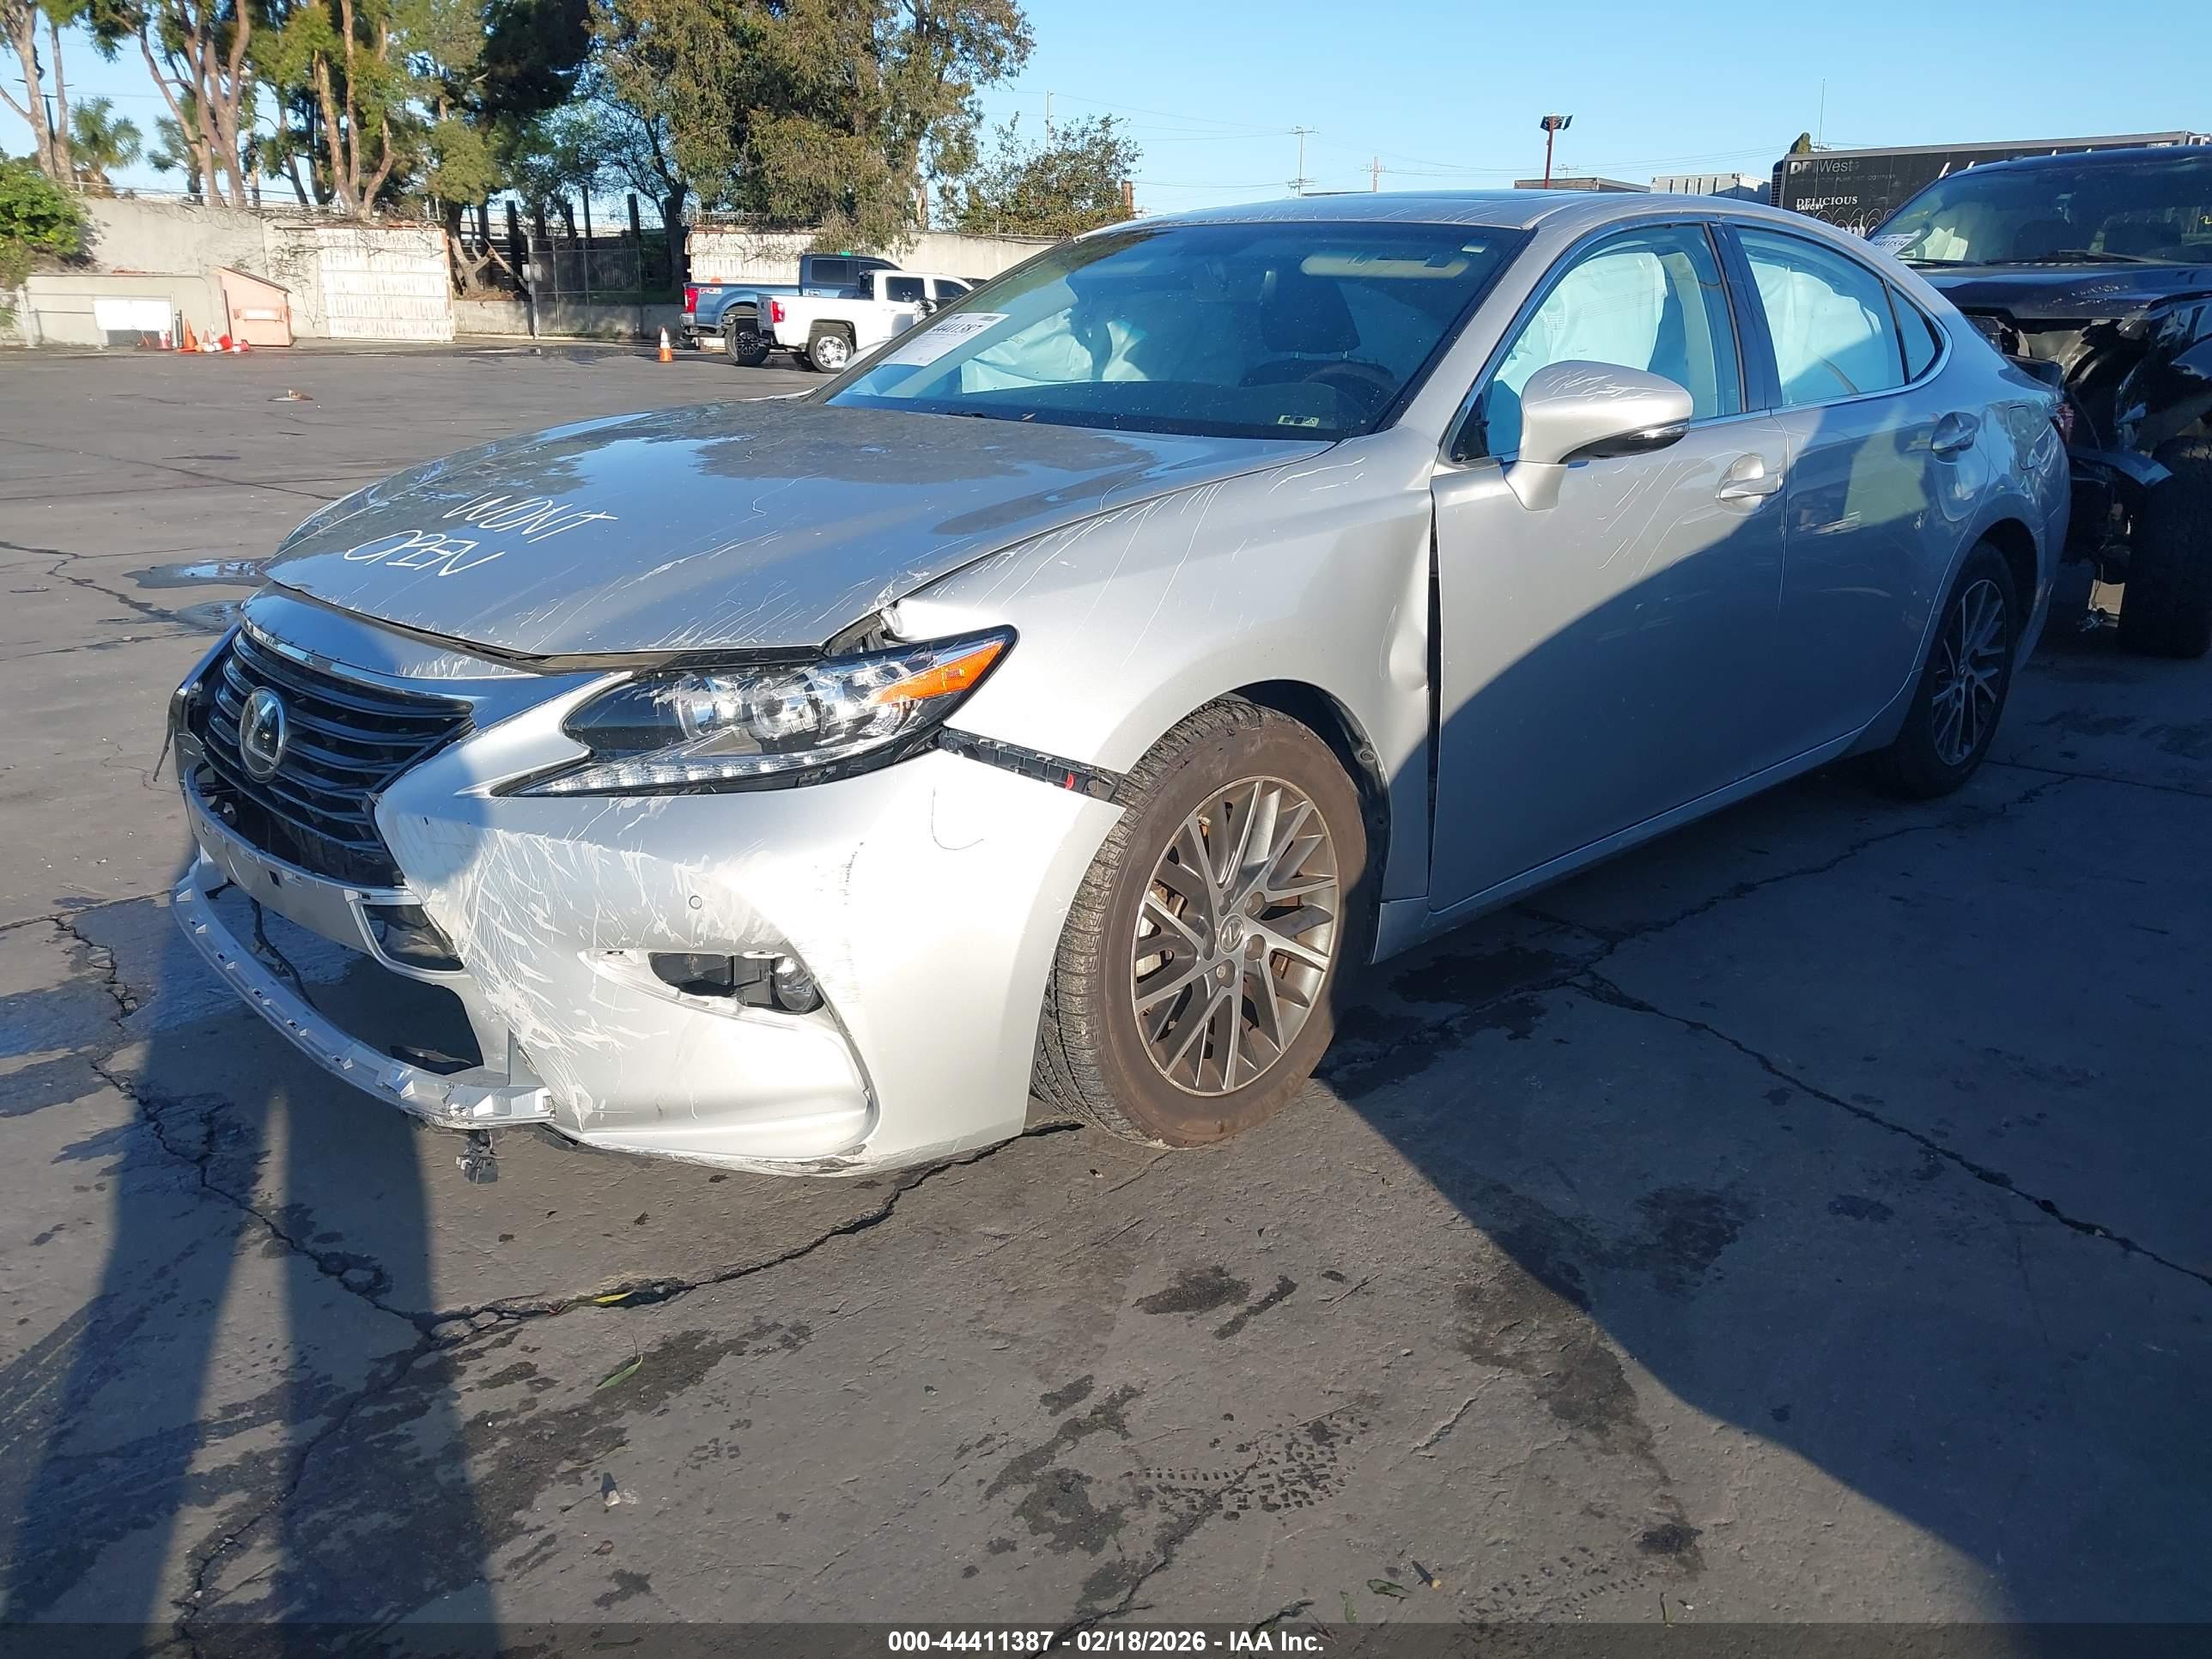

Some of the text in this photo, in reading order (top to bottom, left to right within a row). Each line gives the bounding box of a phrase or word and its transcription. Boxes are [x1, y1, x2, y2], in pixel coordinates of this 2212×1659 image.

[1820, 160, 1855, 173] West
[1796, 196, 1858, 207] DELICIOUS
[443, 492, 618, 544] WONT
[343, 529, 506, 577] OPEN
